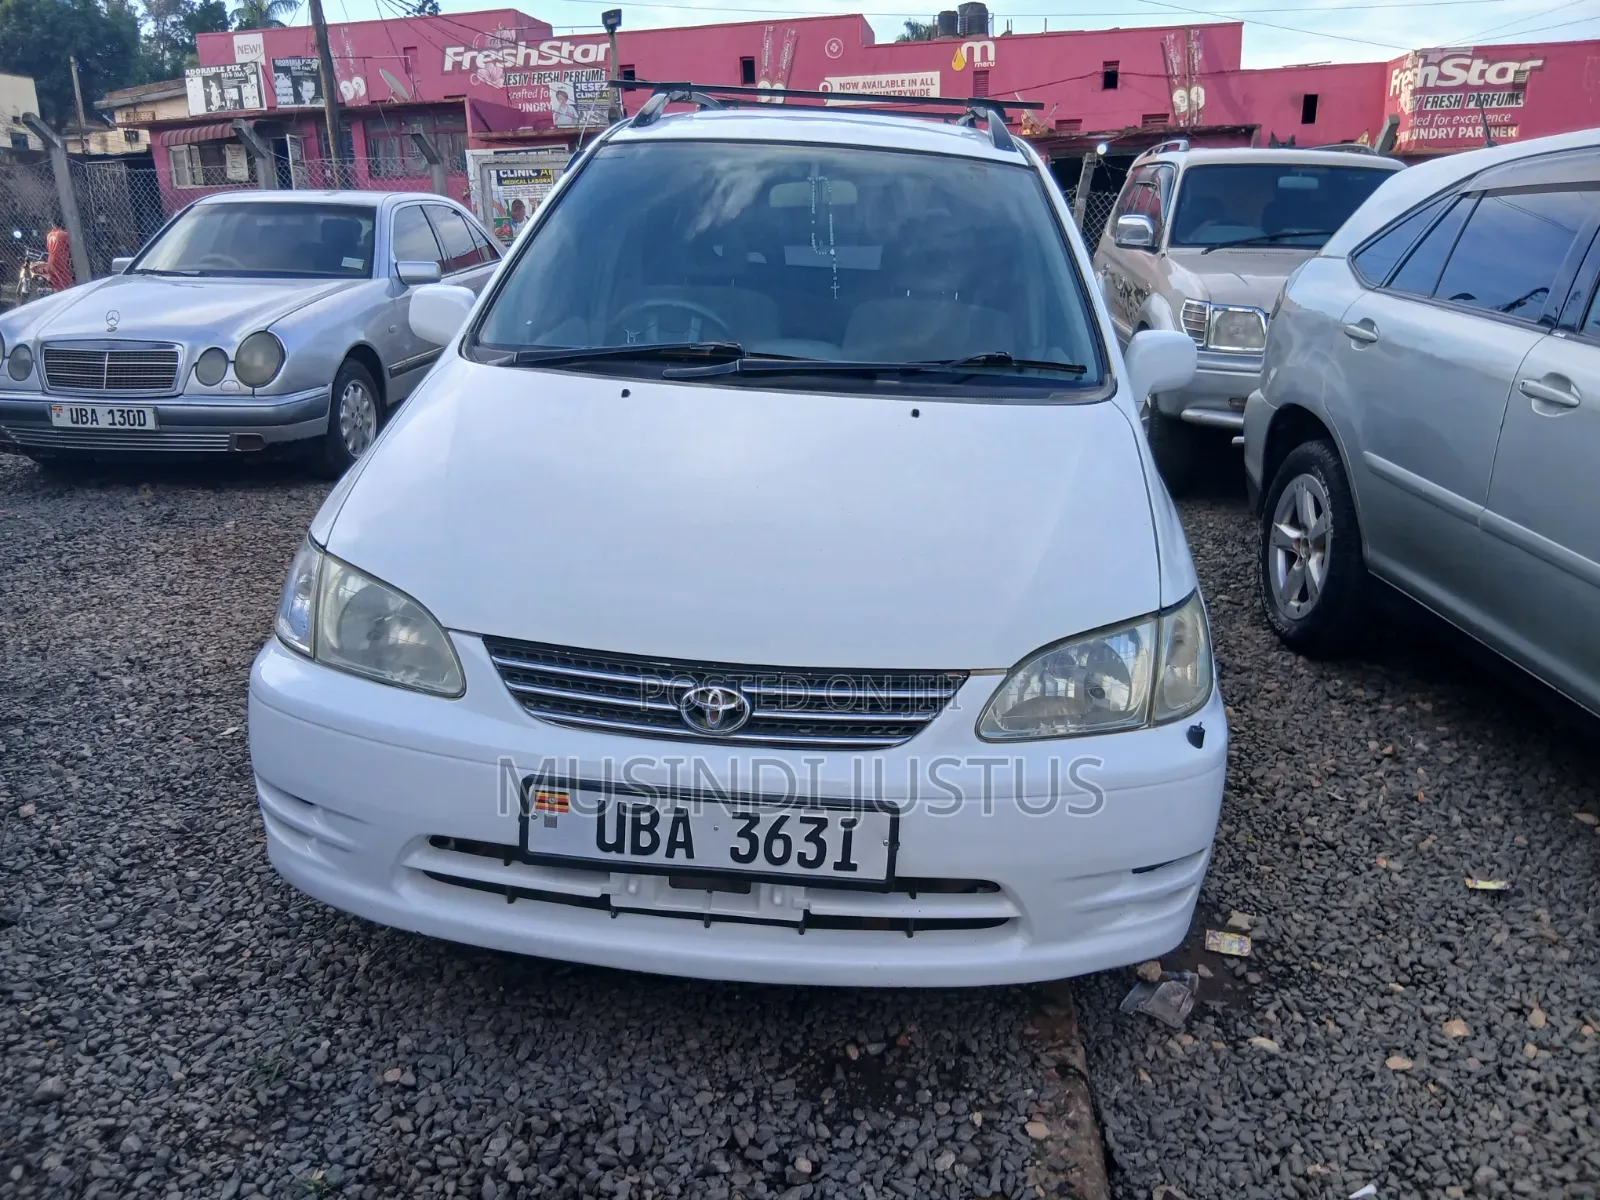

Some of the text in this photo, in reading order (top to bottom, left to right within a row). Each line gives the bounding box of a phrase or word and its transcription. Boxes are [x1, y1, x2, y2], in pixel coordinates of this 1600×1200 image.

[237, 44, 261, 55] NEW!
[443, 41, 611, 72] FreshStar
[185, 66, 226, 76] ADORABLE
[226, 64, 242, 72] PIX
[503, 69, 605, 86] ZESTY FRESH PERFUME
[839, 77, 936, 91] NOW AVAILABLE IN ALL
[1424, 94, 1463, 109] FRESH
[1465, 92, 1522, 108] PERFUME
[1433, 113, 1451, 128] for
[1452, 112, 1512, 124] excelence
[1458, 126, 1517, 139] PARNER
[499, 169, 537, 178] CLINIC
[69, 407, 146, 426] UBA 130D
[595, 799, 695, 860] UBA
